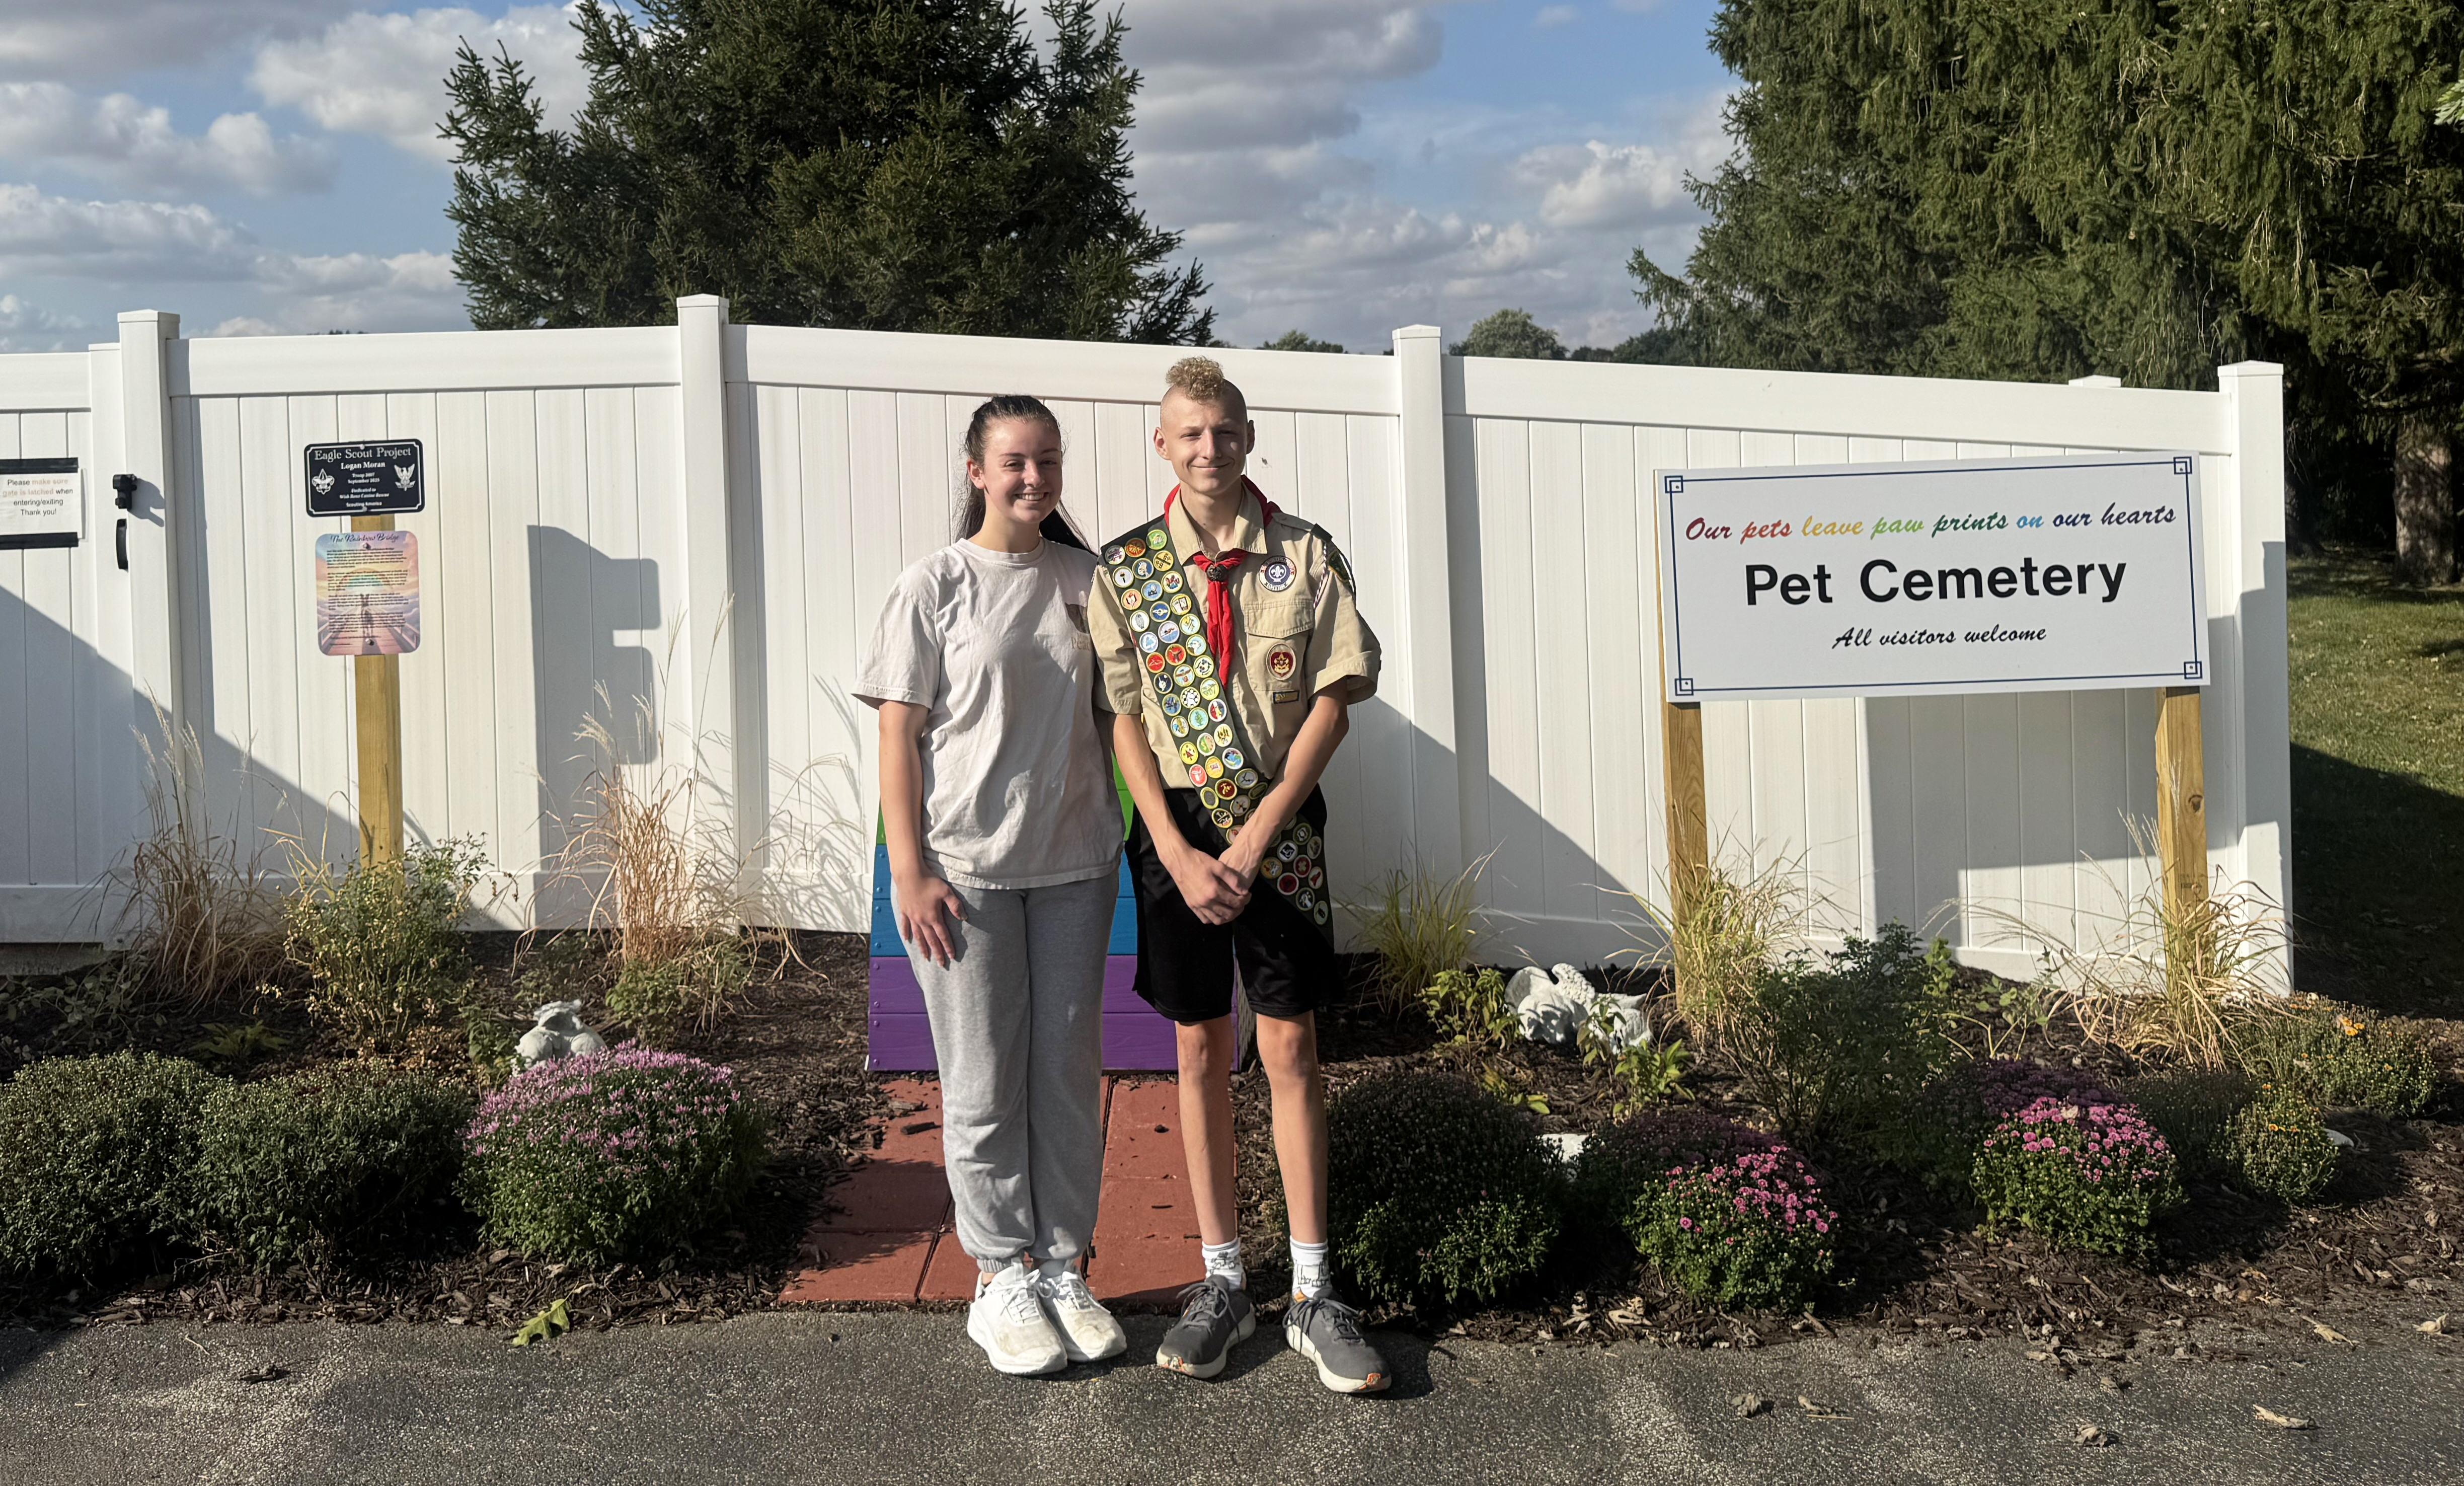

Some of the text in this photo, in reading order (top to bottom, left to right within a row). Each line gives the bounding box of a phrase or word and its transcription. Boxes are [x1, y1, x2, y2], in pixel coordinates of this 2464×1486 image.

[315, 447, 411, 463] Eagle Scout Project
[341, 463, 362, 471] Logan
[13, 498, 63, 506] entering/exiting
[43, 508, 57, 516] you!
[1686, 502, 2176, 544] Our pets leave paw prints on our hearts
[330, 533, 399, 543] The Rainbow Bridge
[1746, 557, 2126, 606] Pet Cemetery
[1832, 624, 2046, 649] All visitors welcome
